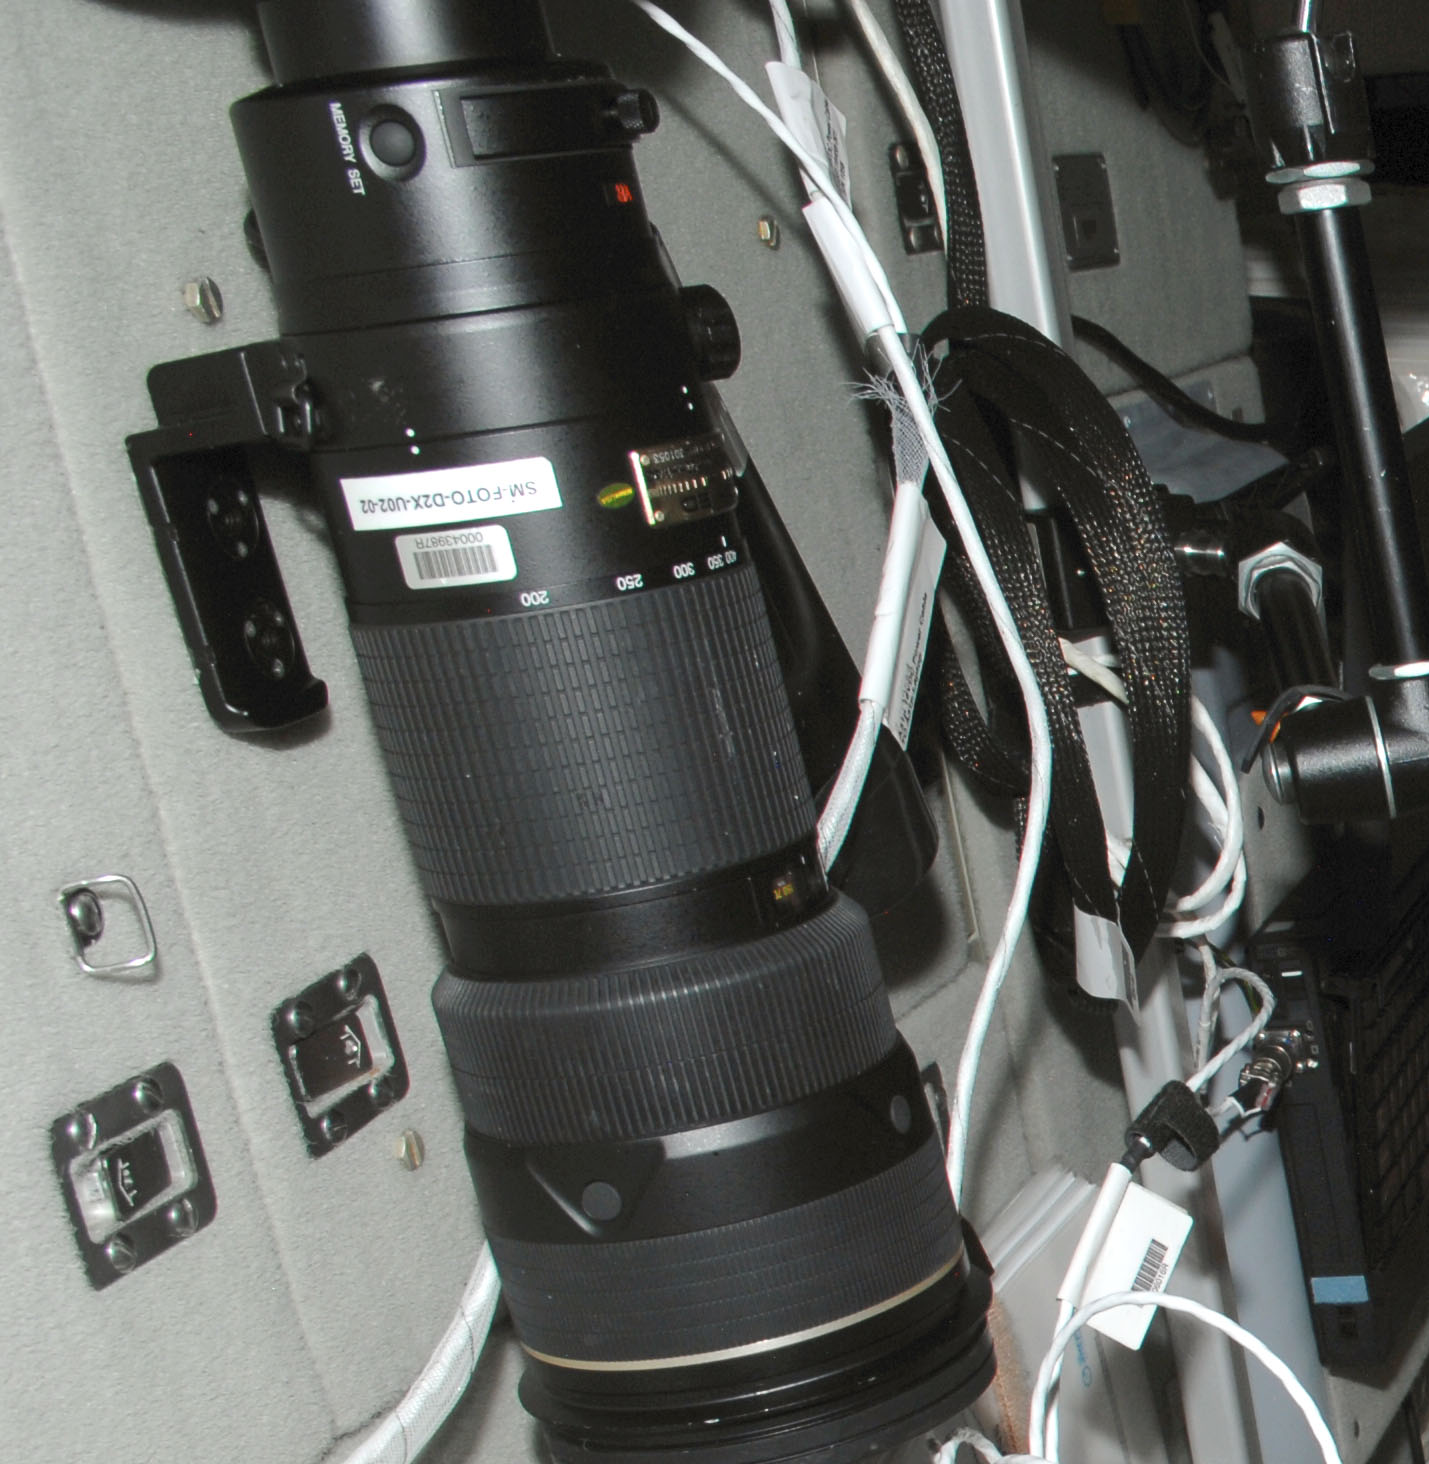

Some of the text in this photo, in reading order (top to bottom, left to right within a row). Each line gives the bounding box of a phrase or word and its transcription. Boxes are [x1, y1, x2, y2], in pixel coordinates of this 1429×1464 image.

[329, 102, 366, 196] MEMORY SET
[360, 481, 538, 515] SM-FOTO-D2X-U02-02
[415, 532, 484, 550] 00043987R
[673, 563, 695, 579] 300
[708, 554, 725, 570] 350
[617, 573, 644, 591] 250
[520, 590, 549, 607] 200
